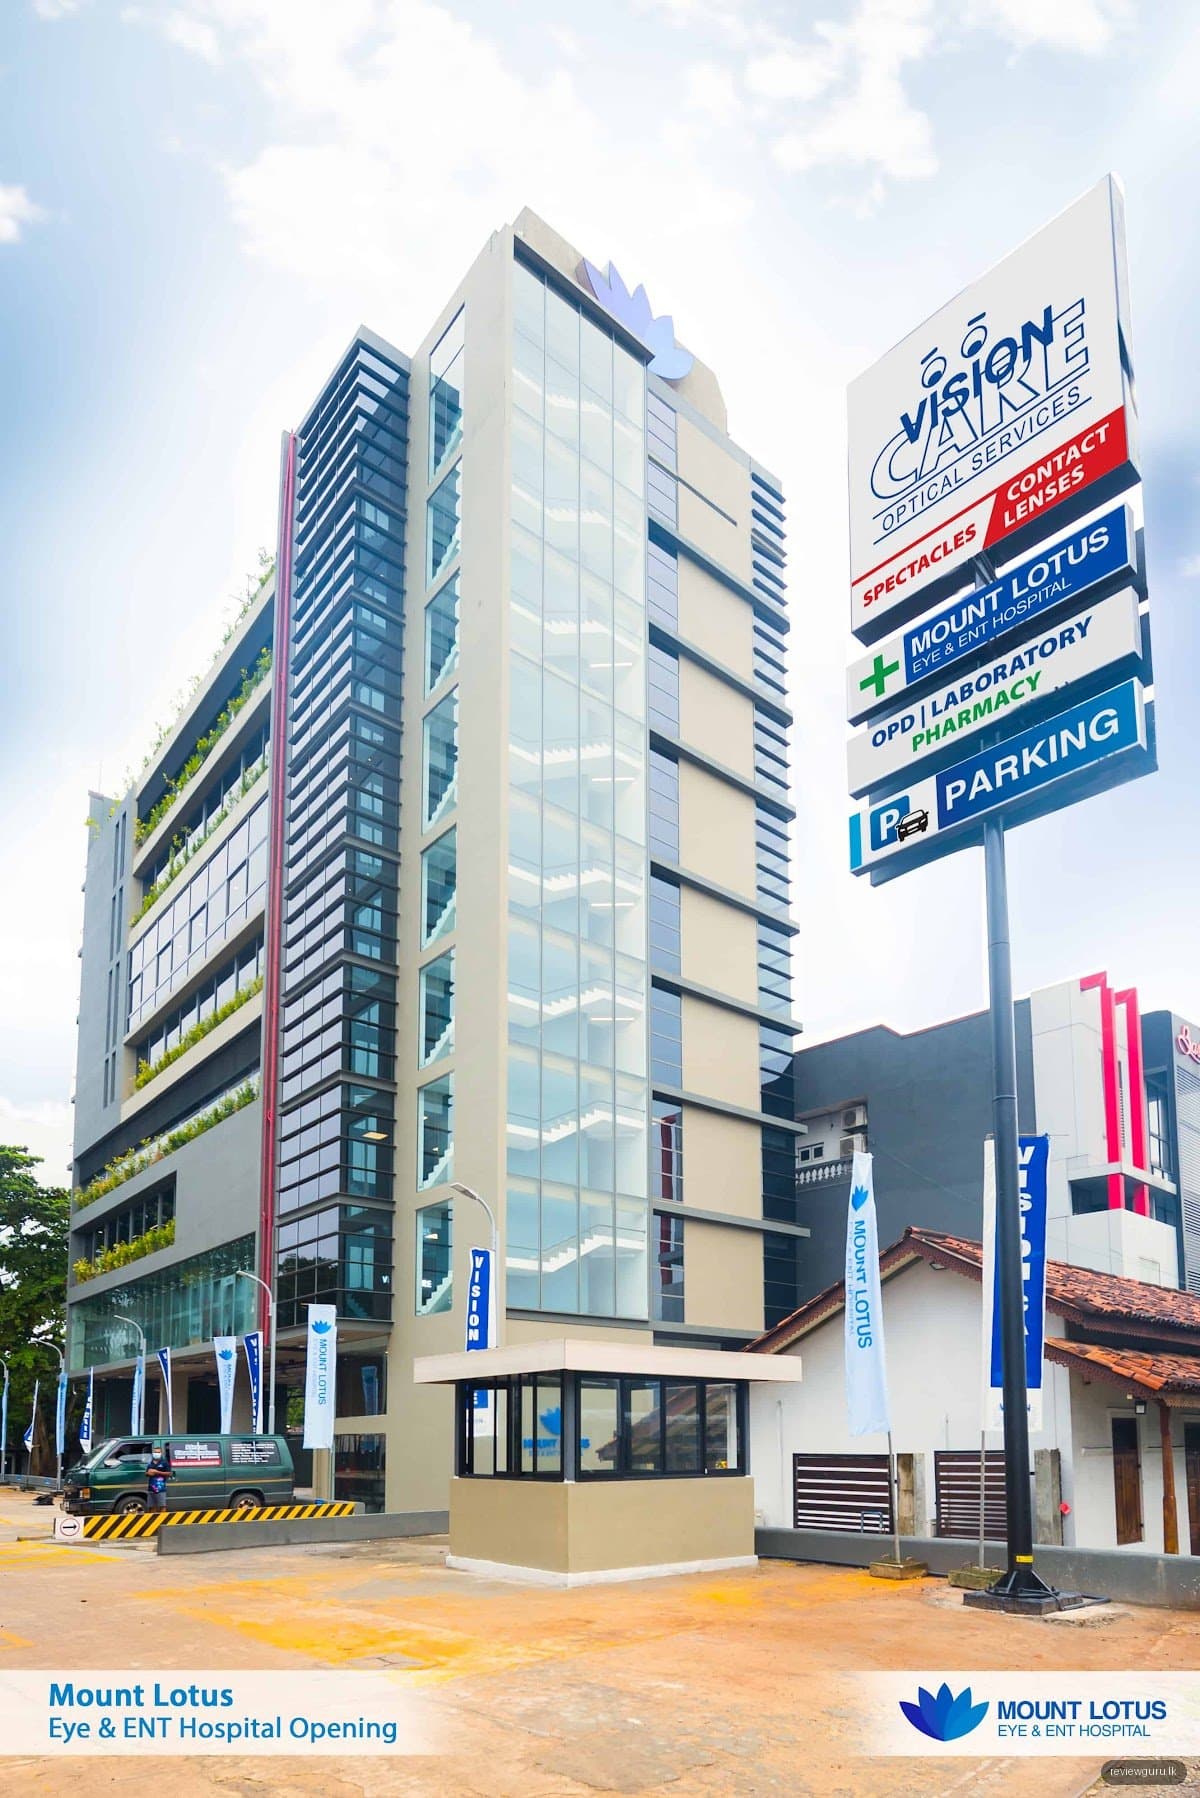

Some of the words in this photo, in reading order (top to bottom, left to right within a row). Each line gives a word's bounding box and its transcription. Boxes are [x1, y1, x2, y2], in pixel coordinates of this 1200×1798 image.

[870, 297, 1089, 500] CARE
[900, 305, 1053, 444] VISION
[882, 474, 965, 532] OPTICAL
[972, 386, 1080, 468] SERVICES
[1003, 465, 1085, 528] LENSES
[1007, 422, 1111, 501] CONTACT
[863, 523, 976, 606] SPECTACLES
[911, 588, 1003, 658] MOUNT
[1012, 526, 1110, 599] LOTUS
[913, 649, 942, 675] EYE
[944, 642, 955, 656] &
[959, 620, 988, 648] ENT
[992, 578, 1072, 630] HOSPITAL
[872, 710, 915, 749] OPD
[931, 616, 1094, 717] LABORATORY
[911, 671, 1043, 753] PHARMACY
[944, 708, 1119, 811] PARKING
[853, 1220, 867, 1284] MOUNT
[468, 1256, 484, 1341] VISION
[855, 1289, 872, 1349] LOTUS
[318, 1374, 327, 1405] LOTUS
[319, 1338, 328, 1372] MOUNT
